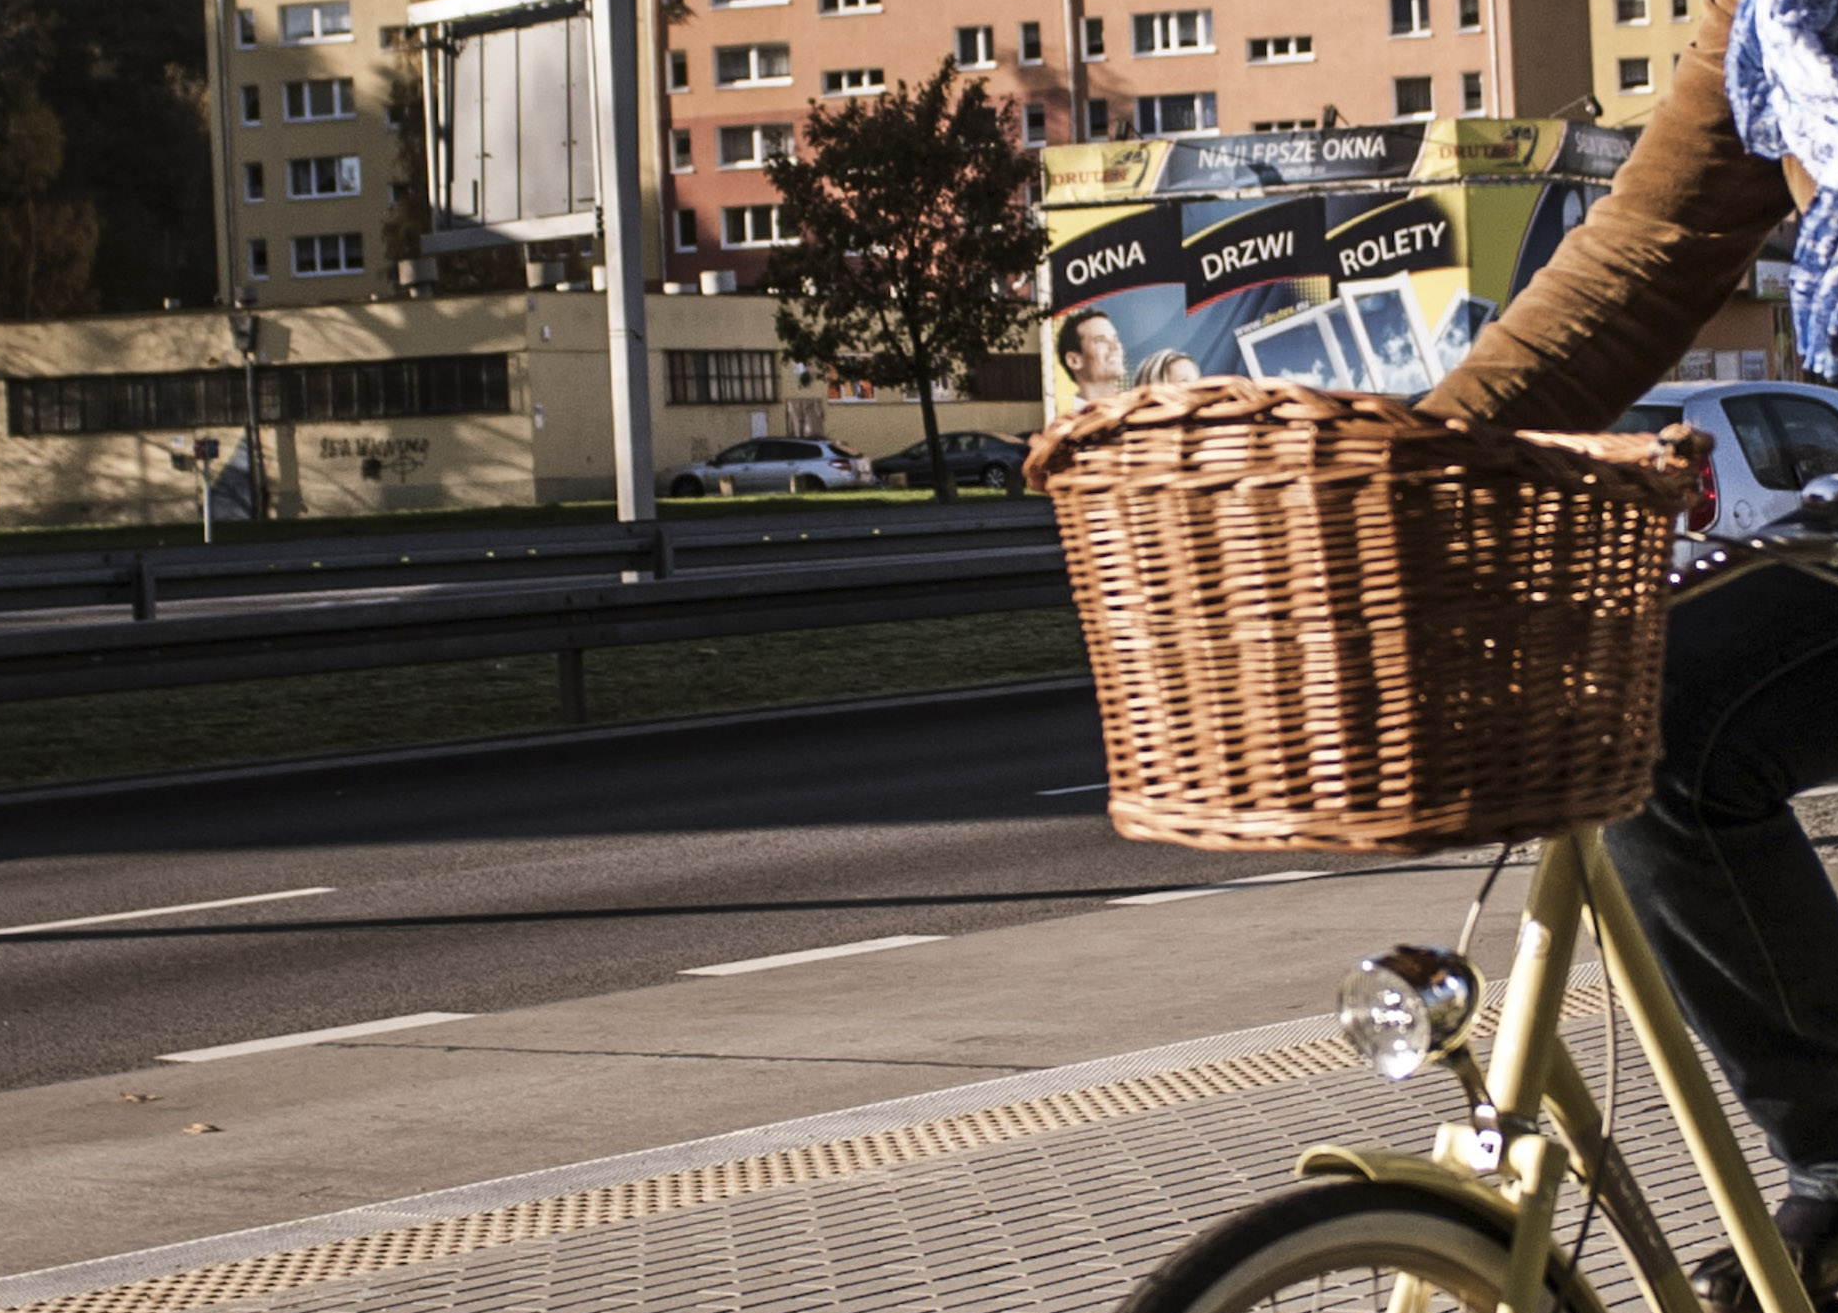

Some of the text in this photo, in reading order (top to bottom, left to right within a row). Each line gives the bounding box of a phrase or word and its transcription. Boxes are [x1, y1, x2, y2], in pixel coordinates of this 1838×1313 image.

[1198, 135, 1387, 170] NAJLEPSZE OKNA
[1065, 239, 1147, 287] OKNA
[1200, 229, 1295, 282] DRZWI
[1338, 221, 1447, 276] ROLETY
